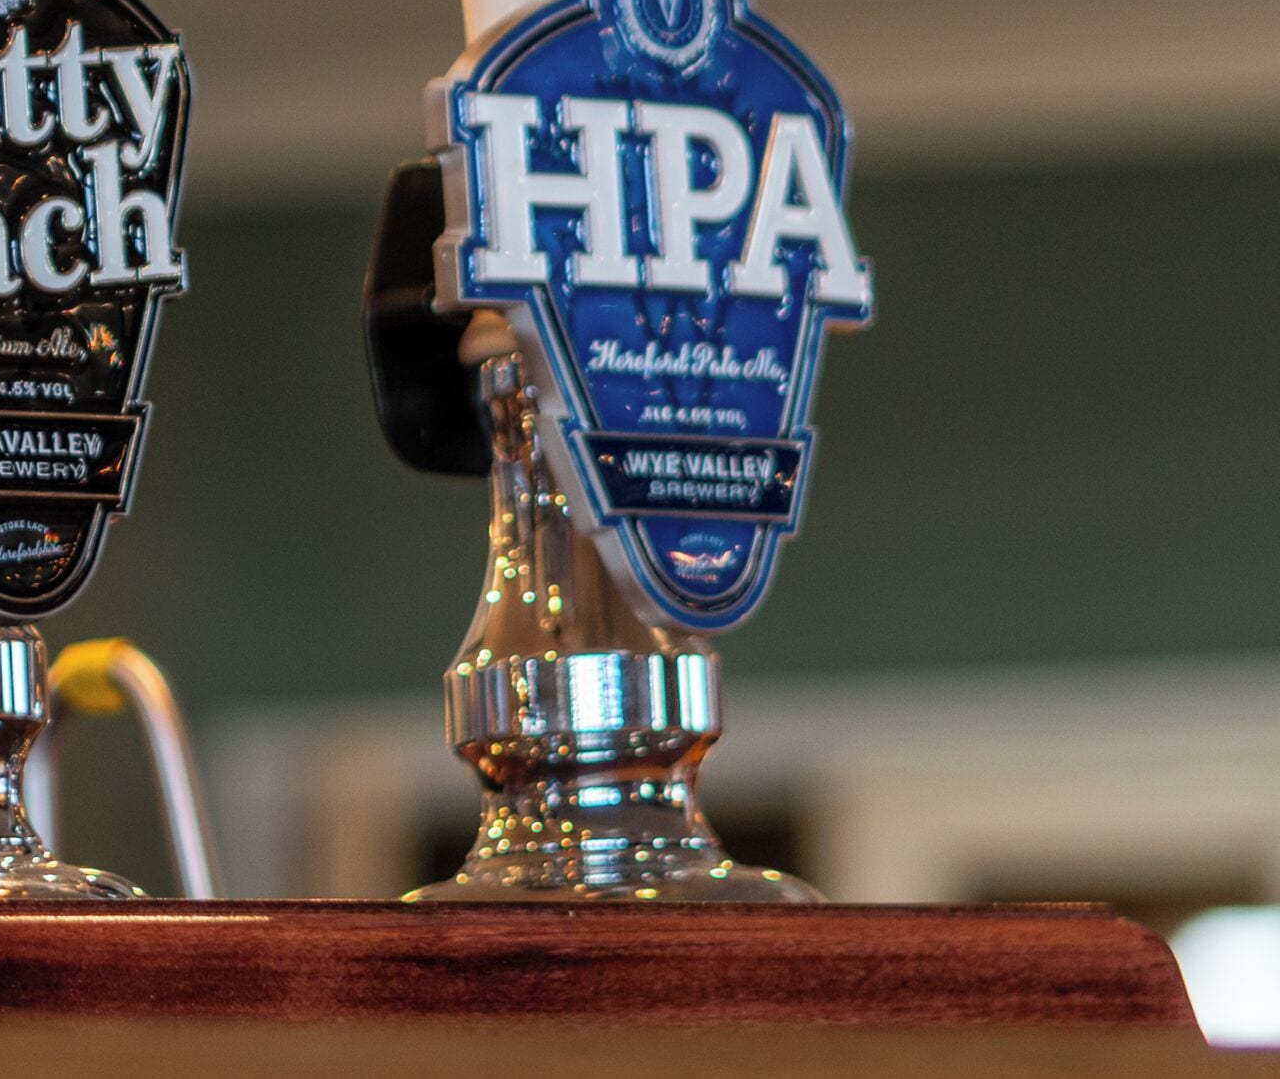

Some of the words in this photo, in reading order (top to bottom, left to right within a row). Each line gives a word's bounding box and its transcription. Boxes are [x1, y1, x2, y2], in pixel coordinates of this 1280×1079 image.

[464, 93, 871, 307] HPA
[589, 339, 689, 381] Hereford
[691, 341, 741, 377] Pale
[42, 383, 73, 398] VOL
[1, 430, 100, 457] VALLEY
[626, 451, 682, 476] WYE
[686, 452, 773, 479] VALLEY
[649, 479, 759, 501] BREWERY
